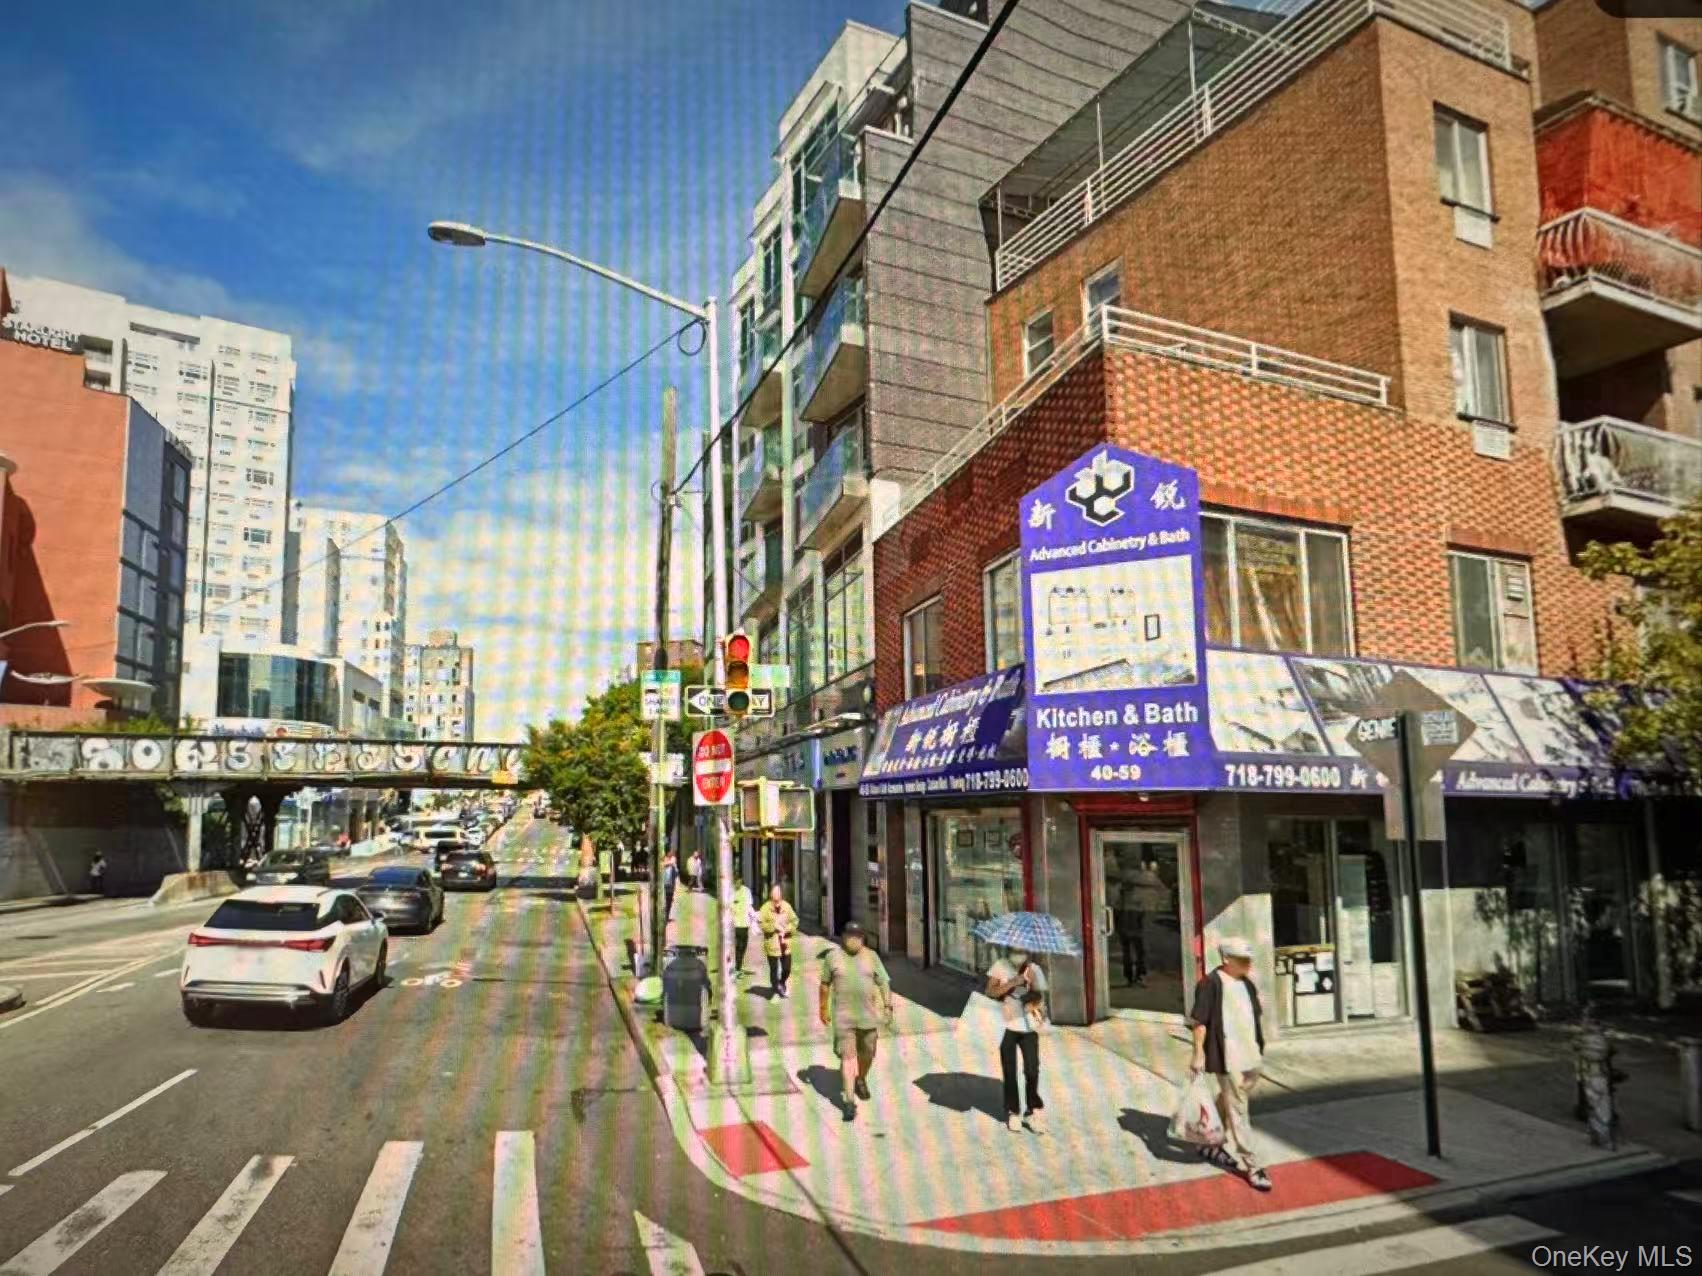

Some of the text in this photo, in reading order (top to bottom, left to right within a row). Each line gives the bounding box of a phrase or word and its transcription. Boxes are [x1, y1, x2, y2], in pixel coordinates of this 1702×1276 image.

[1029, 540, 1087, 562] Advanced
[1087, 534, 1147, 555] Cabinetry
[1160, 527, 1191, 545] Bath
[1036, 701, 1199, 729] Kitchen & Bath
[1224, 763, 1342, 788] 718-799-0600
